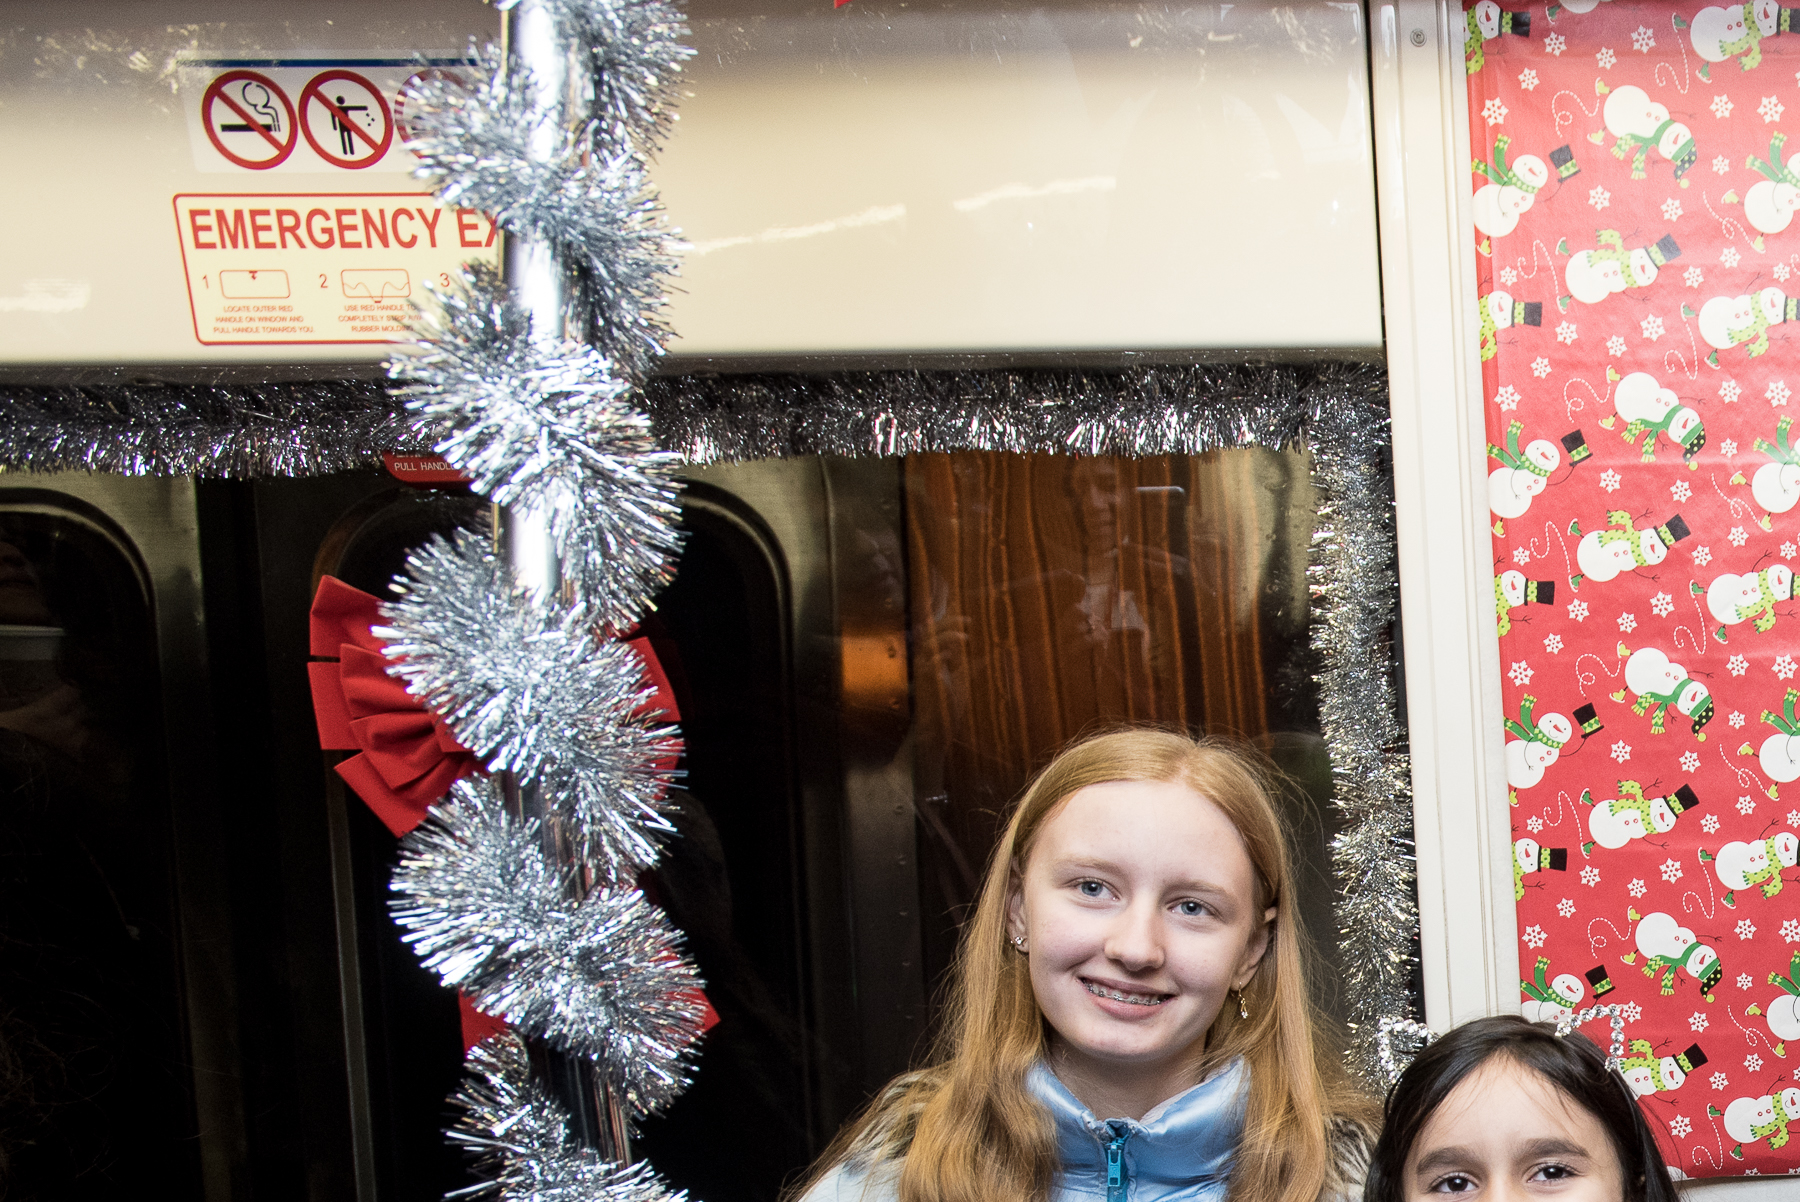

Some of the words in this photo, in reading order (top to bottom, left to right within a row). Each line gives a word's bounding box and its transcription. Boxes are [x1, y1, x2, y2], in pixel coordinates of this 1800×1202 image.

[189, 209, 441, 248] EMERGENCY
[203, 275, 209, 289] 1
[319, 274, 328, 288] 2
[440, 273, 450, 287] 3
[394, 462, 417, 471] PULL
